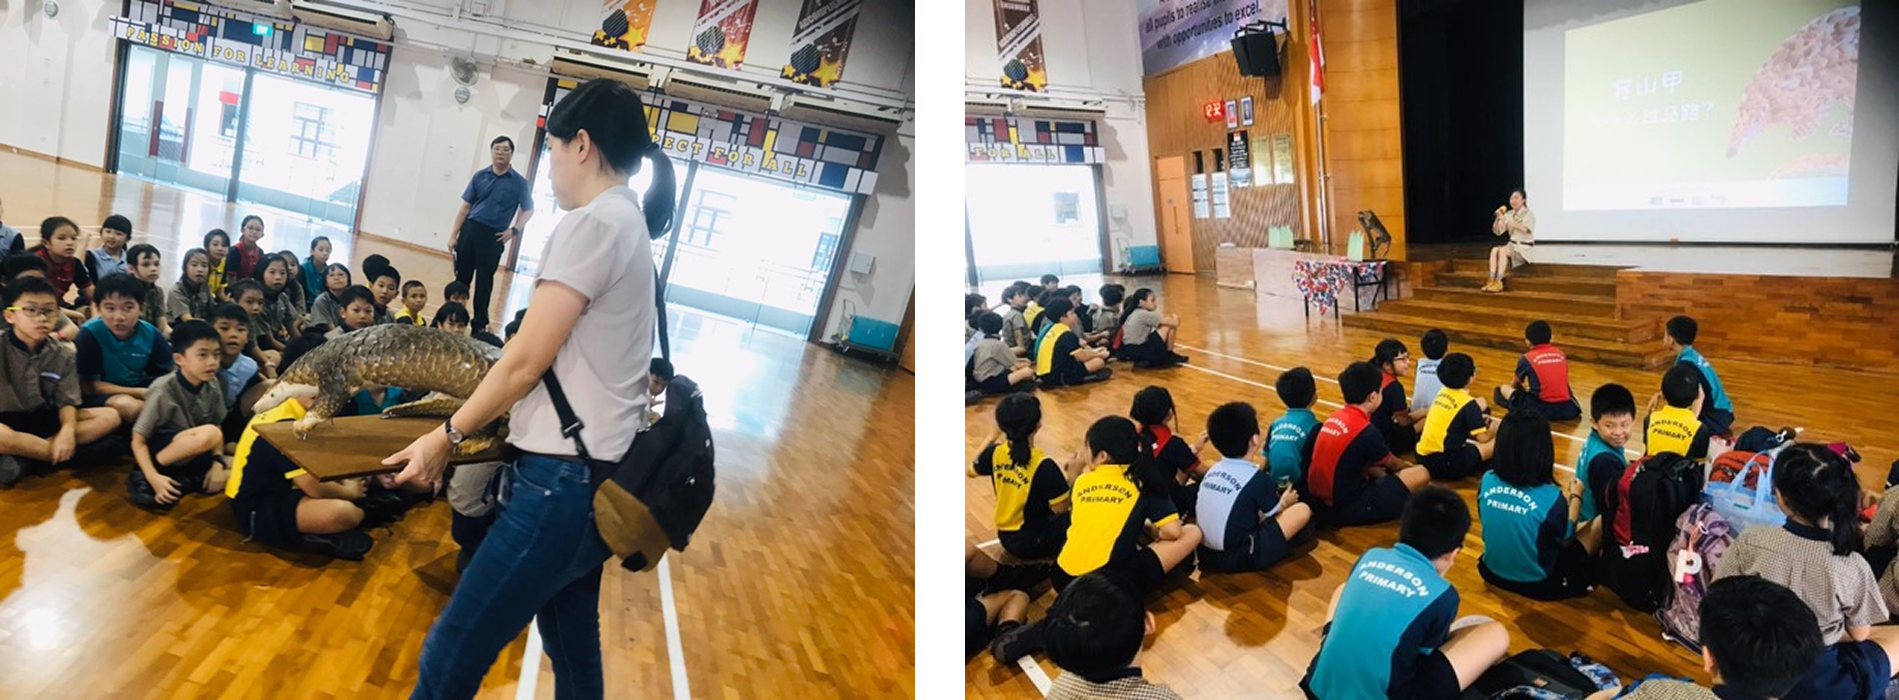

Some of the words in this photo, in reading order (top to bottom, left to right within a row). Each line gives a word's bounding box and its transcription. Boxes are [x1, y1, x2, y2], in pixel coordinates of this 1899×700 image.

[1154, 11, 1176, 32] pupils
[1177, 7, 1185, 20] to
[1157, 33, 1172, 49] with
[1172, 15, 1223, 45] opportunities
[1224, 10, 1234, 25] to
[1234, 0, 1262, 21] excel.
[126, 27, 203, 53] PASSION
[213, 45, 246, 62] FOR
[255, 53, 350, 83] LEARNING
[713, 147, 753, 166] FOR
[766, 157, 806, 176] ALL
[1653, 428, 1686, 440] PRIMARY
[1078, 483, 1133, 499] ANDERSON
[1080, 496, 1124, 504] PRIMARY
[1483, 486, 1538, 511] ANDERSON
[1487, 498, 1528, 515] PRIMARY
[1358, 560, 1429, 597] ANDERSON
[1674, 549, 1702, 582] P
[1358, 571, 1417, 598] PRIMARY
